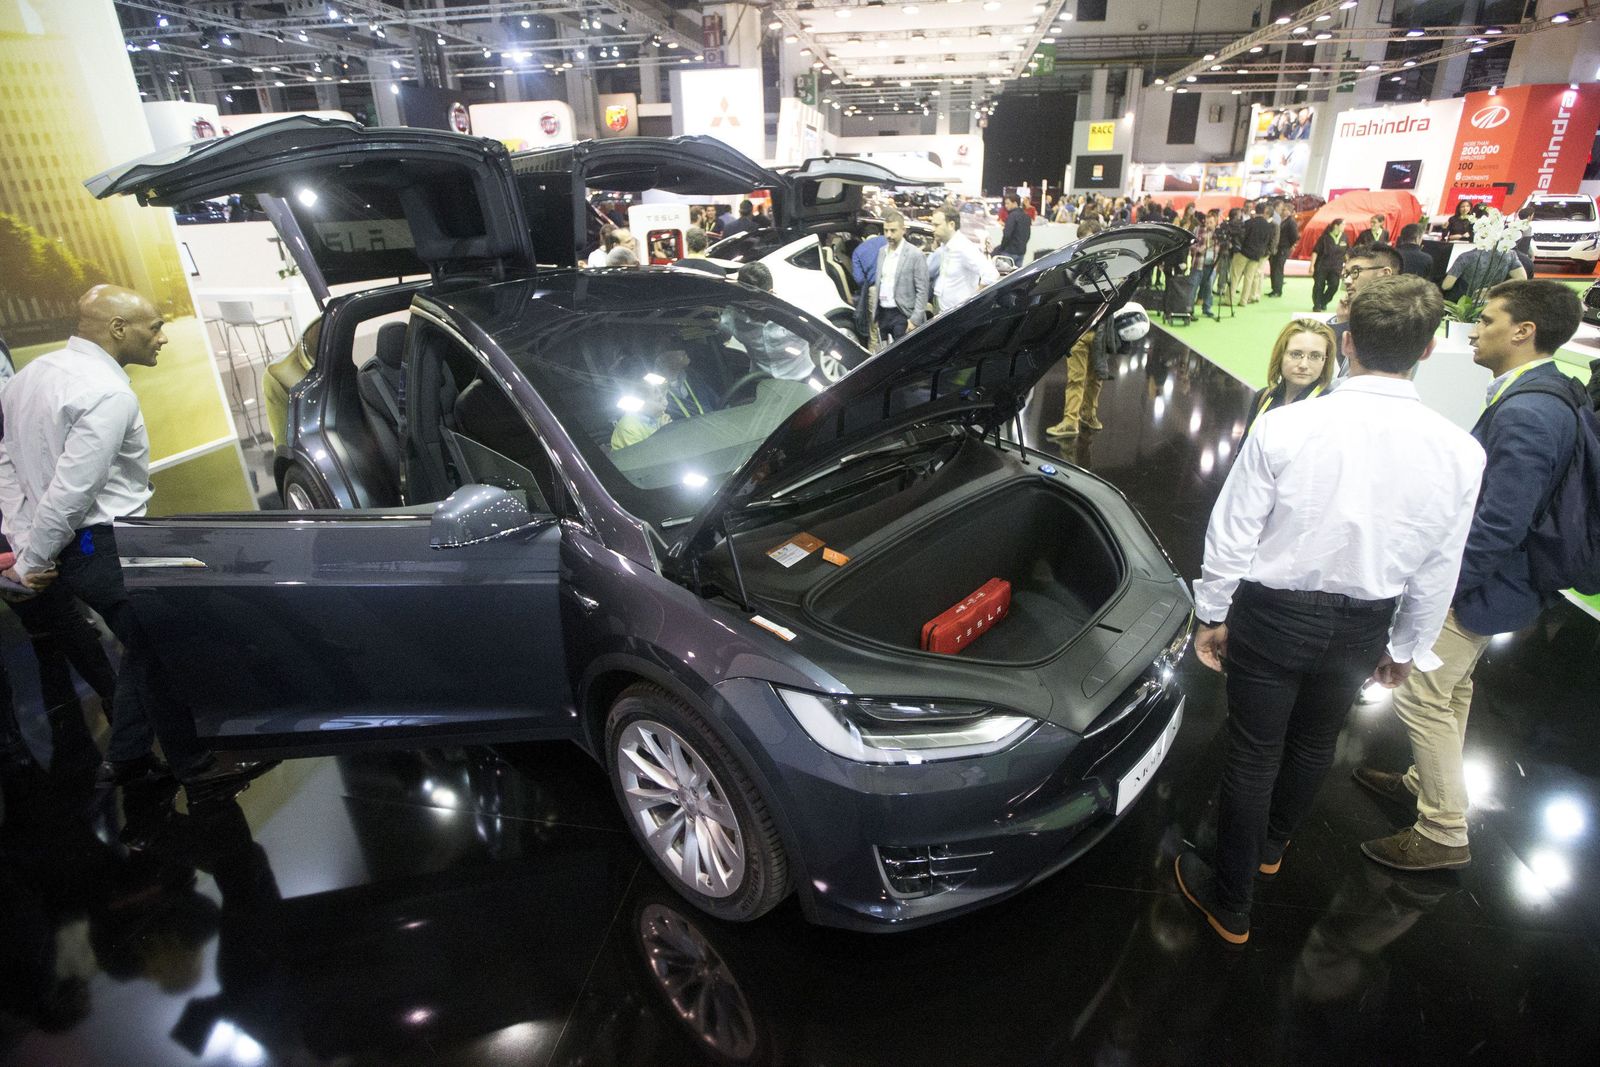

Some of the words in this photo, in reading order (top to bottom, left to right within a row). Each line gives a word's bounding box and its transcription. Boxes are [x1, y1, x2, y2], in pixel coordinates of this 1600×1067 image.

[1091, 125, 1113, 135] RACC
[1340, 115, 1431, 138] Mahindra
[1461, 144, 1500, 155] 200.000
[1458, 162, 1474, 171] 100
[956, 605, 1002, 644] TESLA
